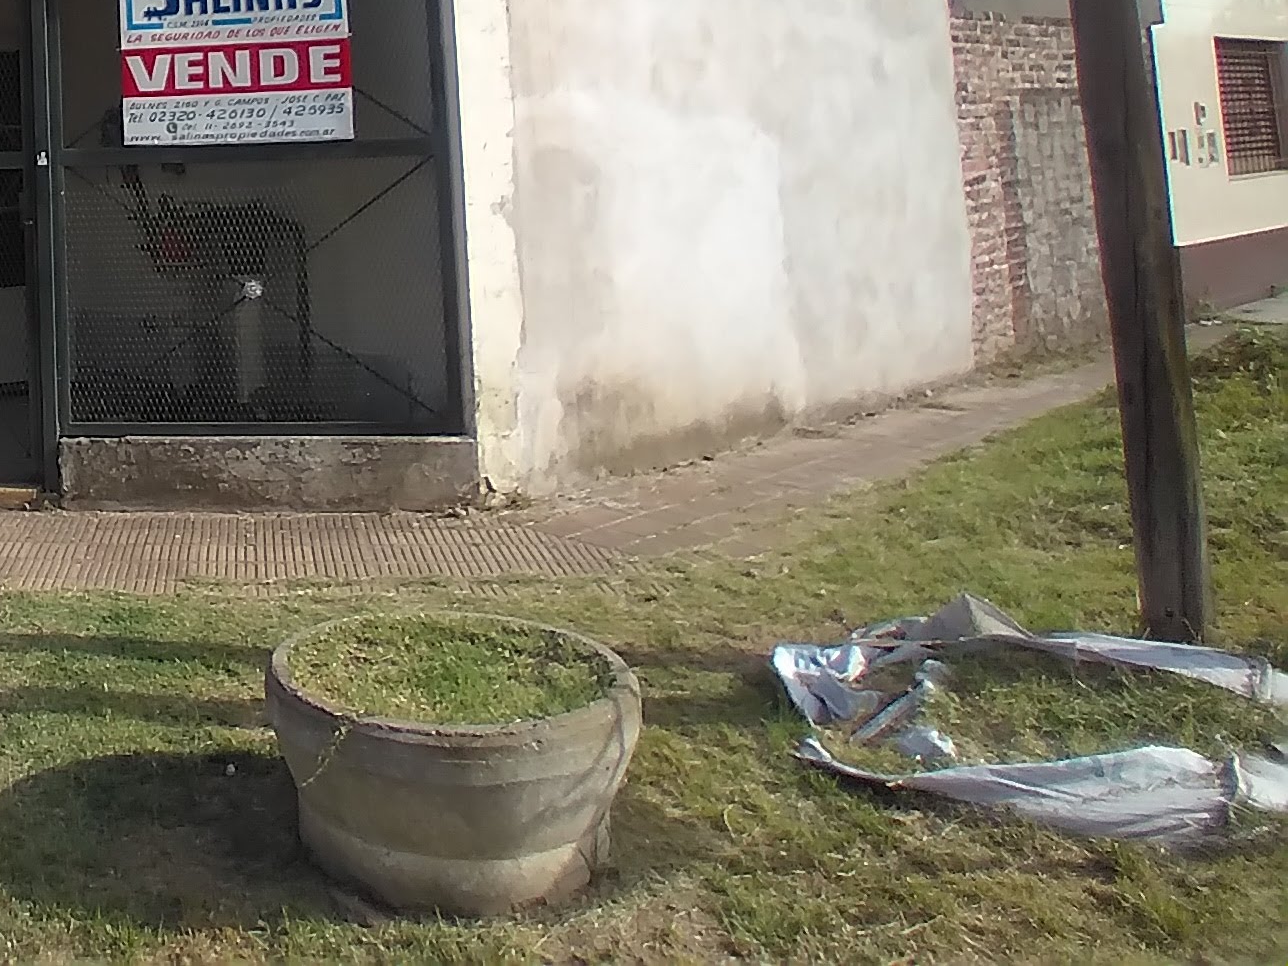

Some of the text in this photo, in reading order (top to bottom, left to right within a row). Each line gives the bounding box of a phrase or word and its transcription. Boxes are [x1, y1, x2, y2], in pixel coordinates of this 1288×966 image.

[251, 13, 317, 24] PROPIEDADES
[127, 23, 341, 44] LA SEGURIDAD DE LOS QUE ELIGEN
[125, 44, 342, 93] VENDE
[227, 97, 269, 106] CAMPOS
[281, 94, 309, 104] JOSE
[324, 92, 346, 102] PAZ
